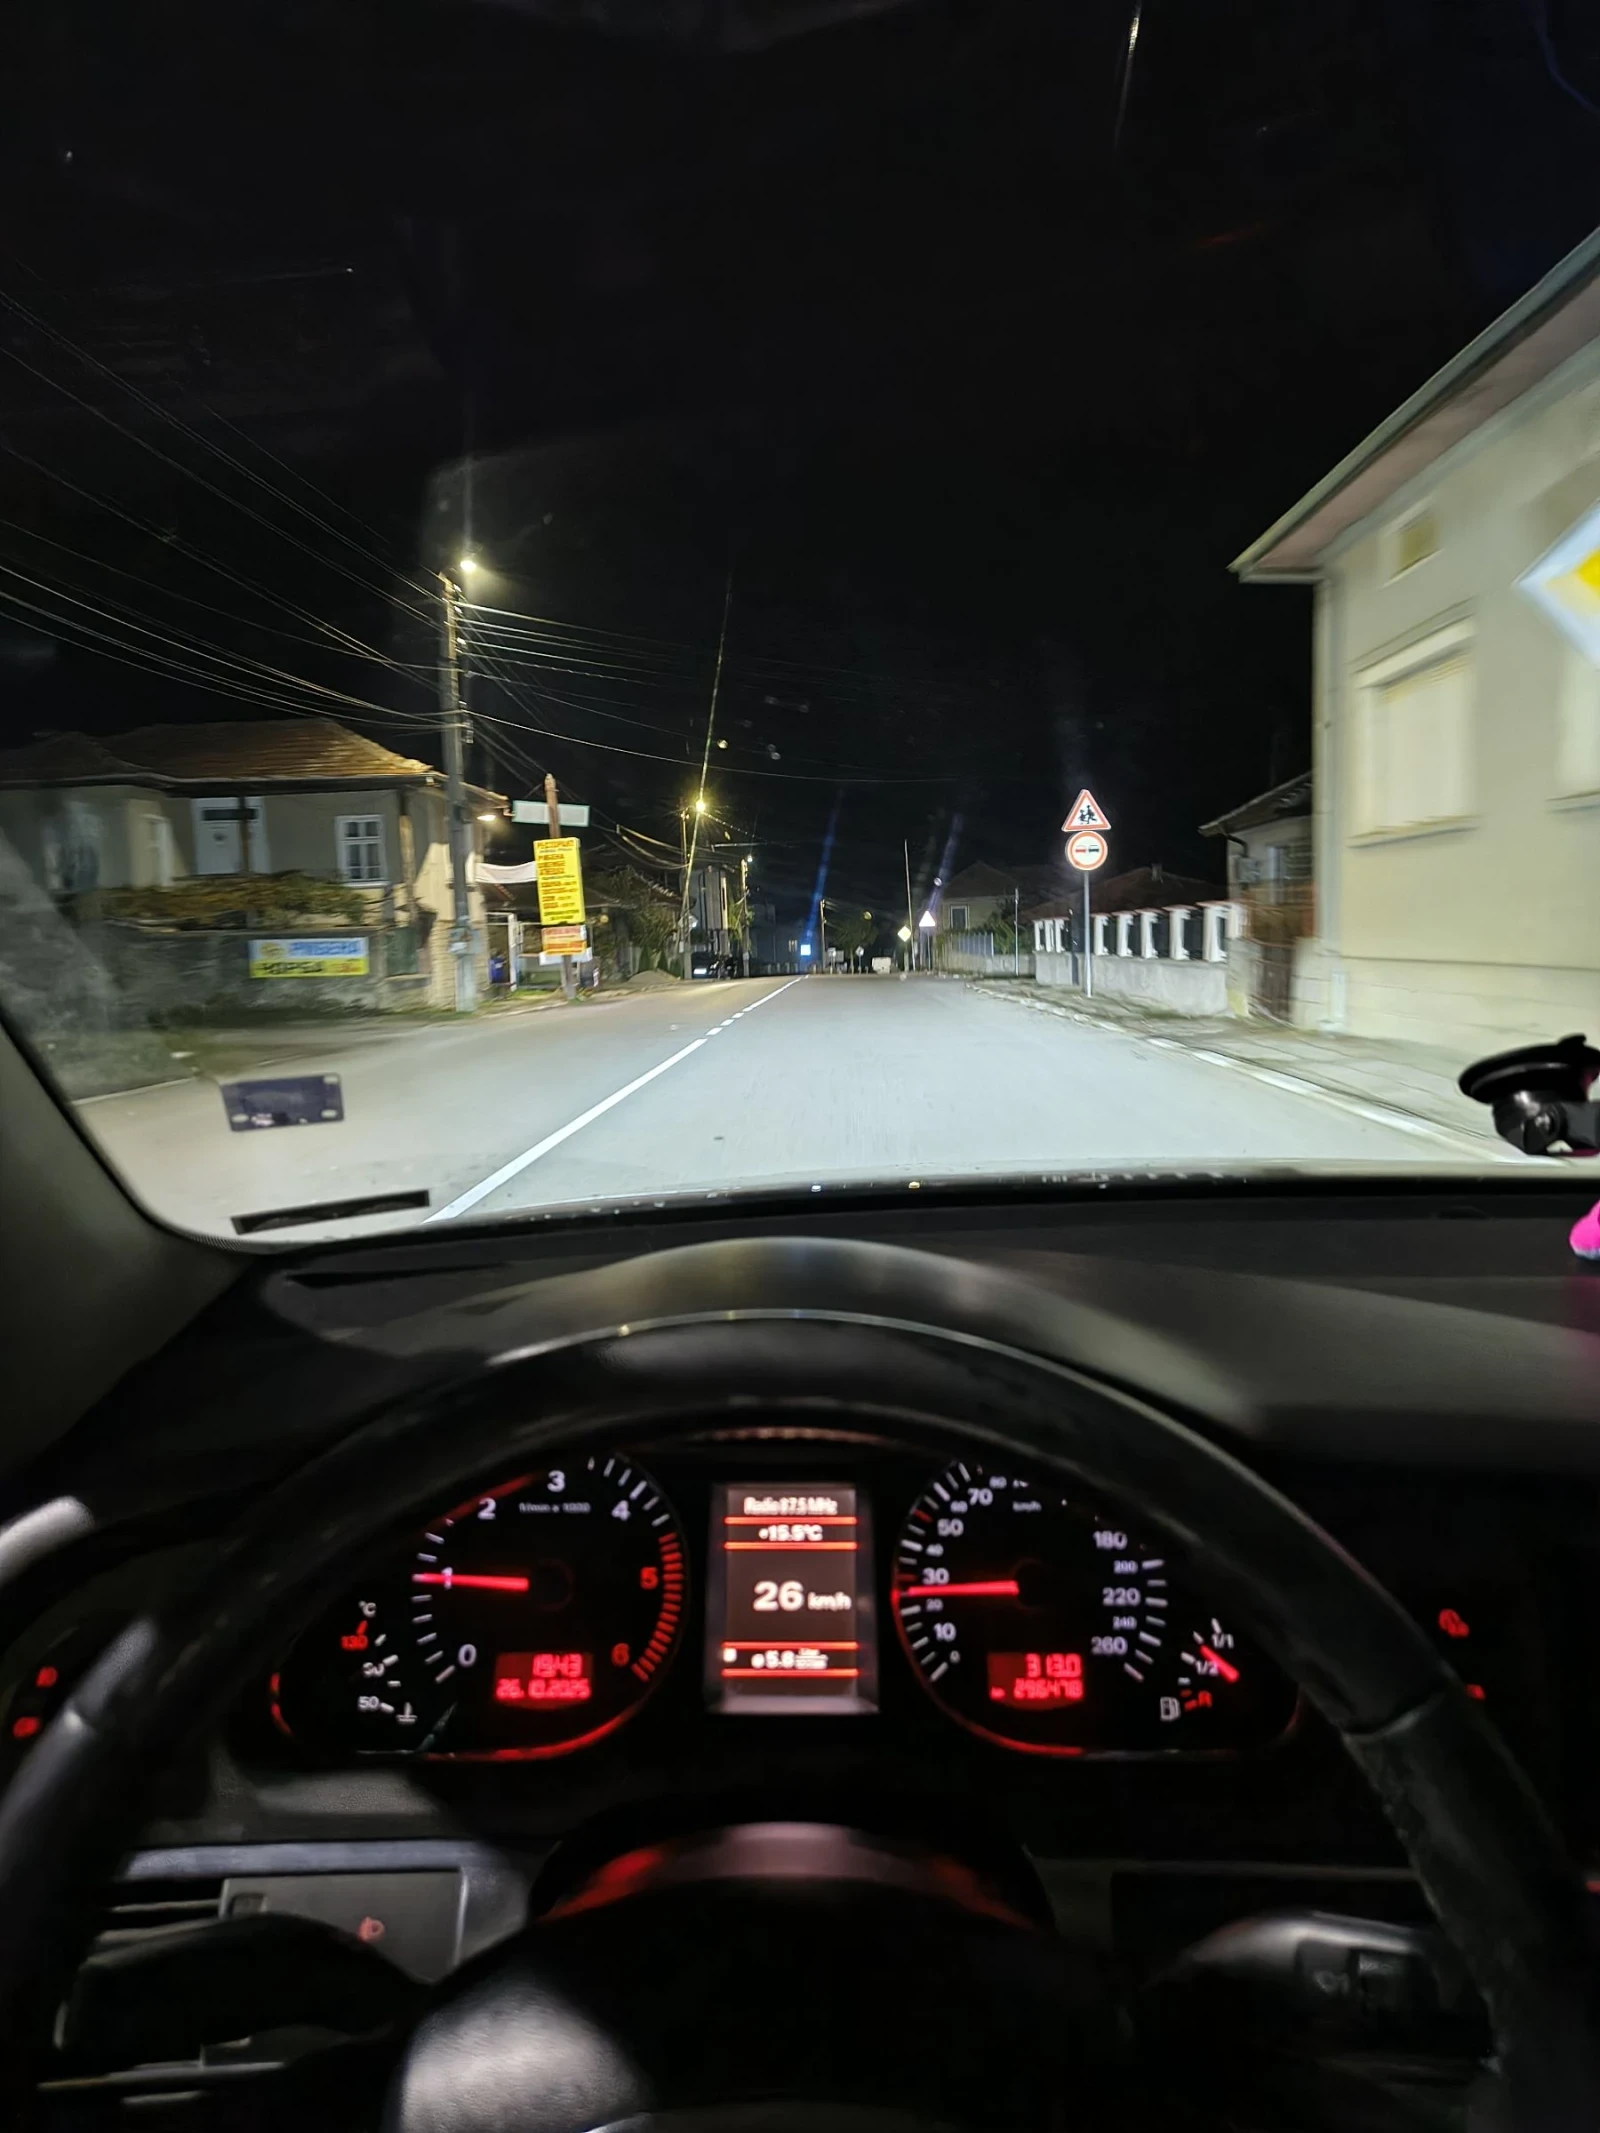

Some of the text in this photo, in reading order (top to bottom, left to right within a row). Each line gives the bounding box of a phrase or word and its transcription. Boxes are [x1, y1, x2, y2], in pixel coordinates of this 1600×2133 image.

[547, 1469, 567, 1493] 3
[967, 1487, 993, 1506] 70
[478, 1497, 497, 1520] 2
[611, 1500, 630, 1521] 4
[937, 1518, 964, 1537] 50
[1093, 1530, 1128, 1550] 180
[441, 1567, 454, 1590] 1
[639, 1567, 659, 1590] 5
[922, 1567, 950, 1585] 30
[753, 1580, 852, 1613] 26 km/h
[1102, 1587, 1141, 1607] 220
[358, 1600, 377, 1618] °C
[933, 1622, 957, 1641] 10
[1211, 1633, 1235, 1649] 1/1
[340, 1635, 369, 1651] 130
[1091, 1636, 1128, 1656] 260
[457, 1643, 477, 1667] 0
[611, 1643, 630, 1666] 6
[950, 1650, 961, 1663] 0
[357, 1695, 380, 1711] 50
